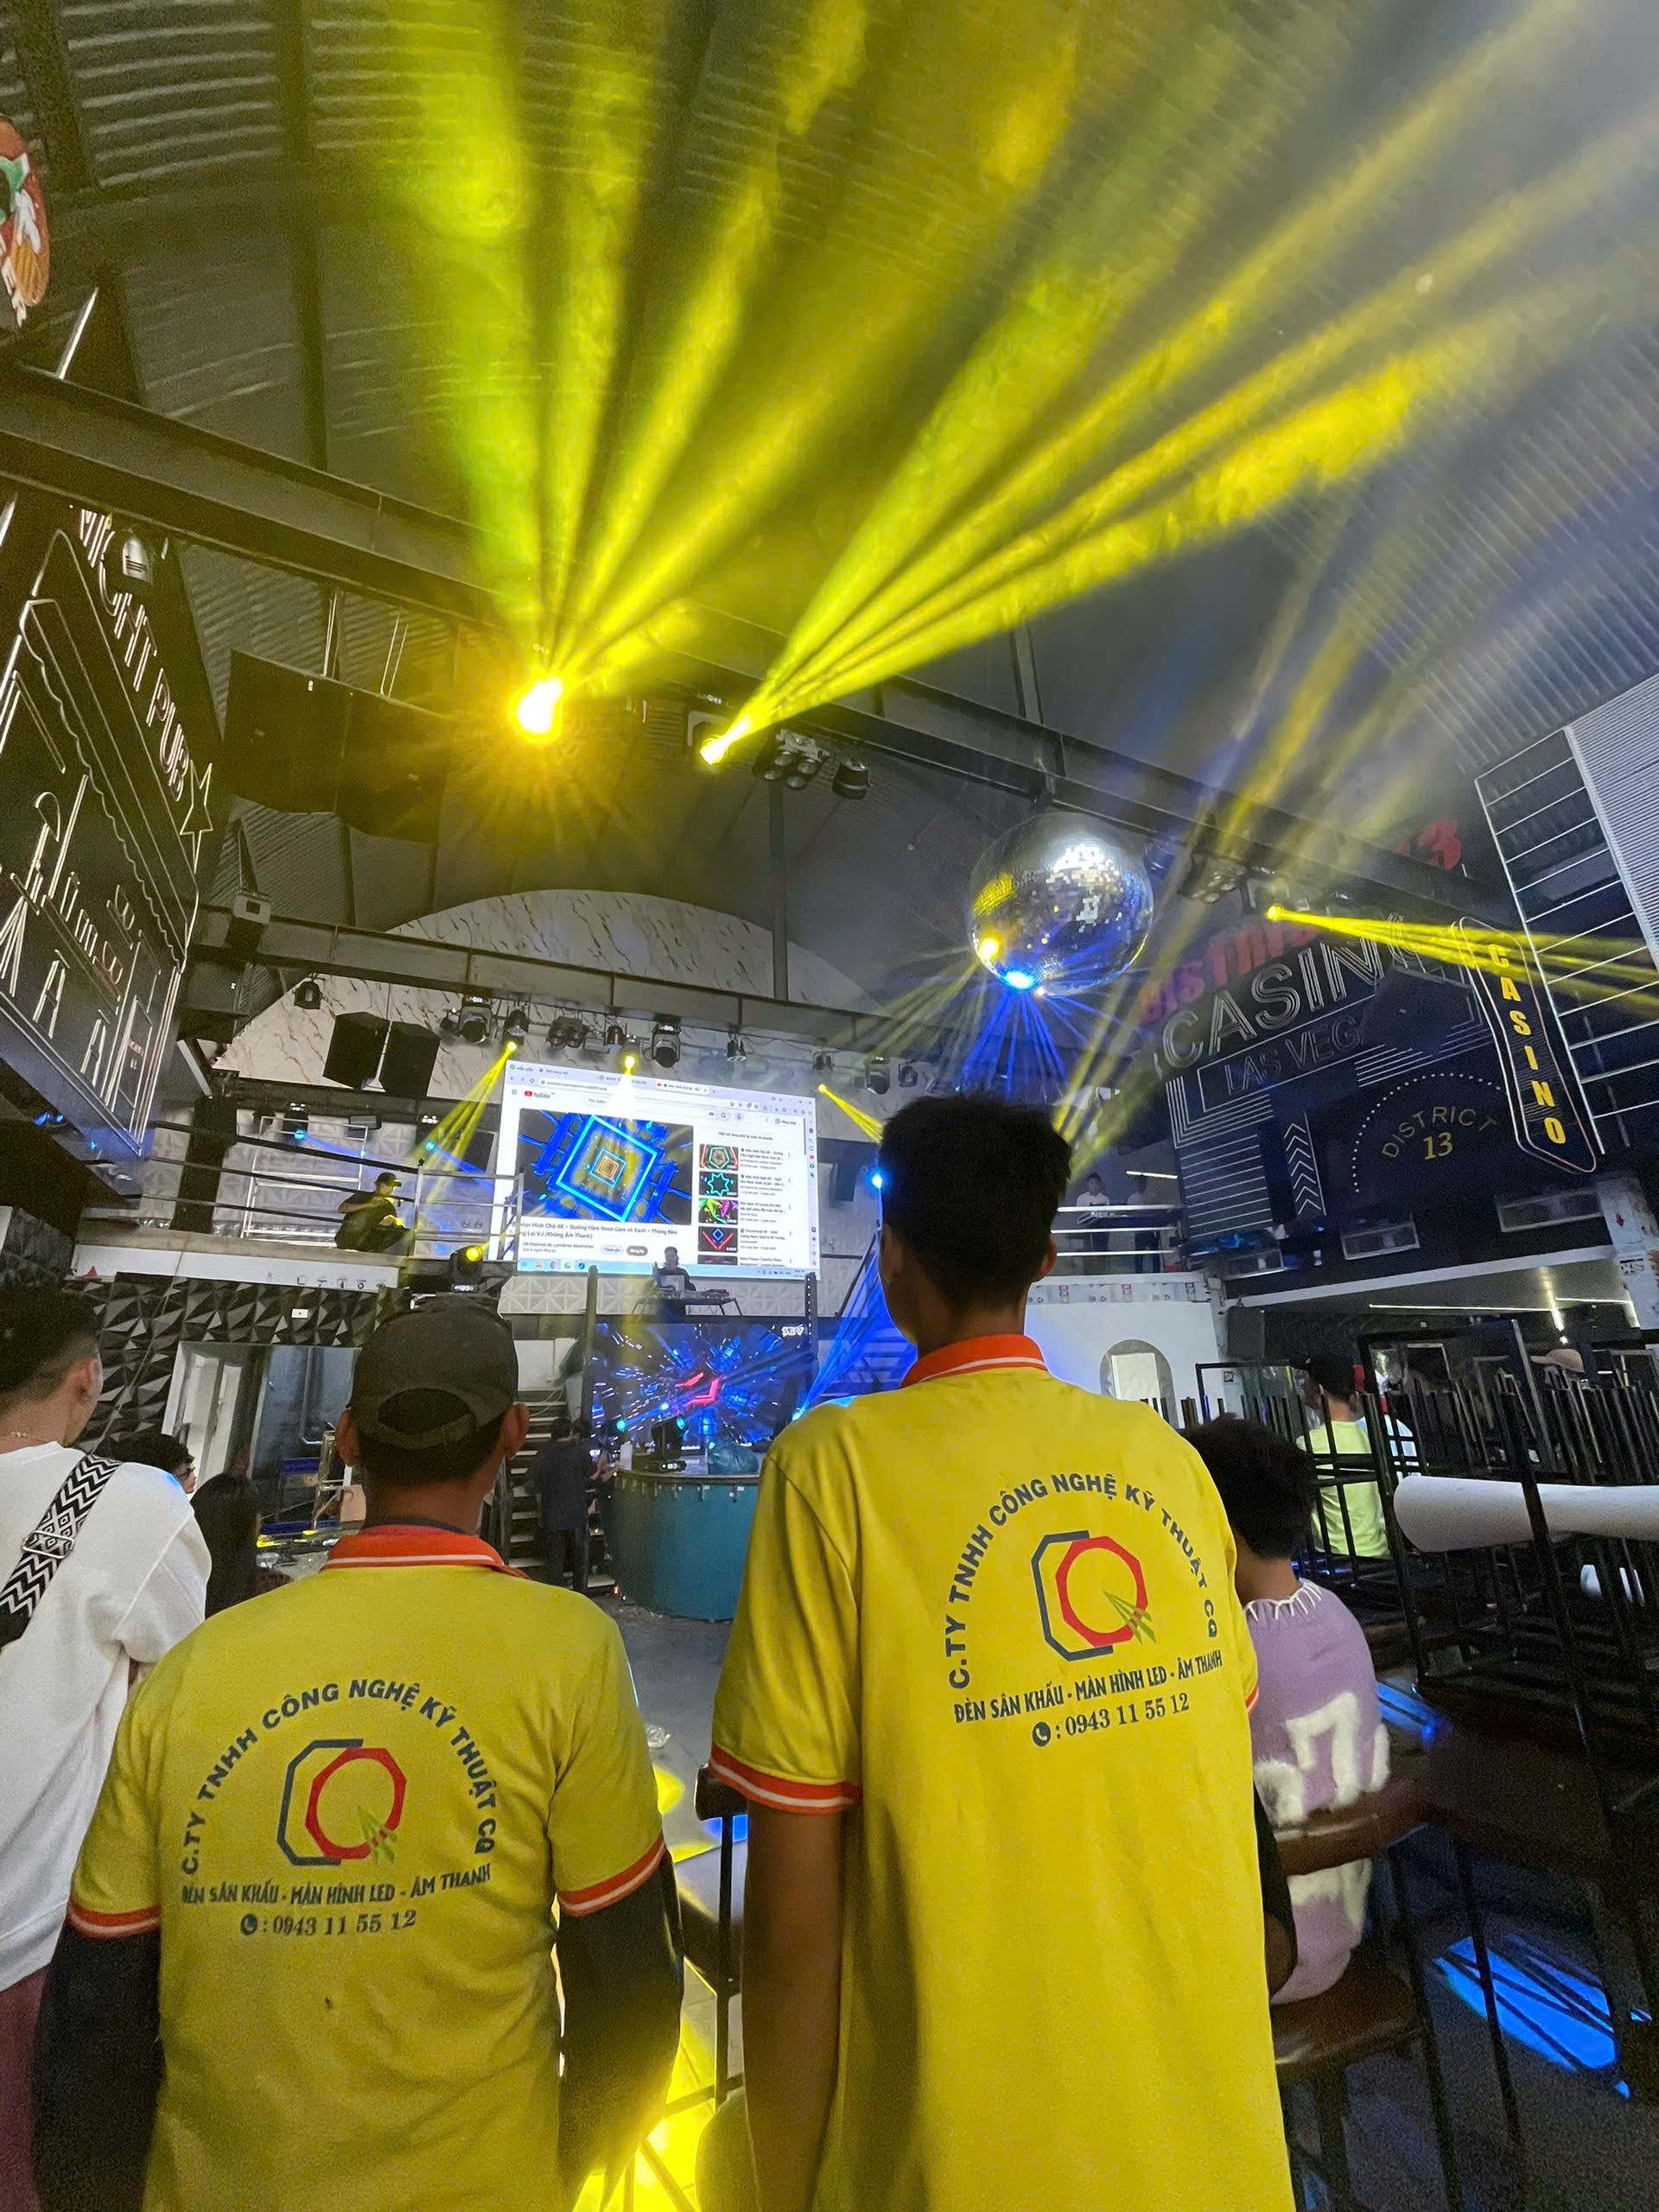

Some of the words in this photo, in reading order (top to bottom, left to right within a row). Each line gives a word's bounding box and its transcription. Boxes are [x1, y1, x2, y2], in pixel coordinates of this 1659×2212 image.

[146, 667, 191, 802] PUB
[1285, 1014, 1365, 1071] VEG
[1488, 944, 1567, 1145] CASINO
[1382, 1106, 1498, 1160] DISTRICT
[1423, 1131, 1454, 1160] 13
[988, 1478, 1049, 1528] CÔNG
[1051, 1472, 1117, 1501] NGHỆ
[949, 1523, 994, 1605] TNHH
[1161, 1508, 1208, 1589] THUẬT
[945, 1614, 970, 1689] C.TY
[954, 1702, 986, 1724] ĐÈN
[990, 1693, 1021, 1719] SÂN
[1024, 1681, 1064, 1713] KHẤU
[1074, 1674, 1107, 1701] MÀN
[1109, 1669, 1145, 1696] HÌNH
[1147, 1664, 1167, 1688] LED
[1177, 1657, 1195, 1680] ÂM
[1196, 1649, 1224, 1675] THANH
[1065, 1708, 1111, 1737] 0943
[1118, 1703, 1139, 1726] 11
[1145, 1698, 1166, 1719] 55
[1170, 1692, 1190, 1714] 12
[181, 1811, 206, 1875] C.TY
[197, 1727, 259, 1803] TNHH
[262, 1683, 340, 1731] CÔNG
[348, 1678, 421, 1712] NGHỆ
[419, 1696, 457, 1728] KỸ
[449, 1726, 498, 1810] THUẬT
[208, 1880, 238, 1904] SÂN
[241, 1878, 280, 1903] KHẤU
[289, 1881, 323, 1905] MÀN
[325, 1881, 365, 1905] HÌNH
[368, 1882, 395, 1902] LED
[410, 1875, 435, 1899] ÂM
[441, 1862, 492, 1891] THANH
[272, 1914, 318, 1936] 0943
[325, 1914, 346, 1936] 11
[355, 1912, 382, 1934] 55
[391, 1909, 417, 1931] 12
